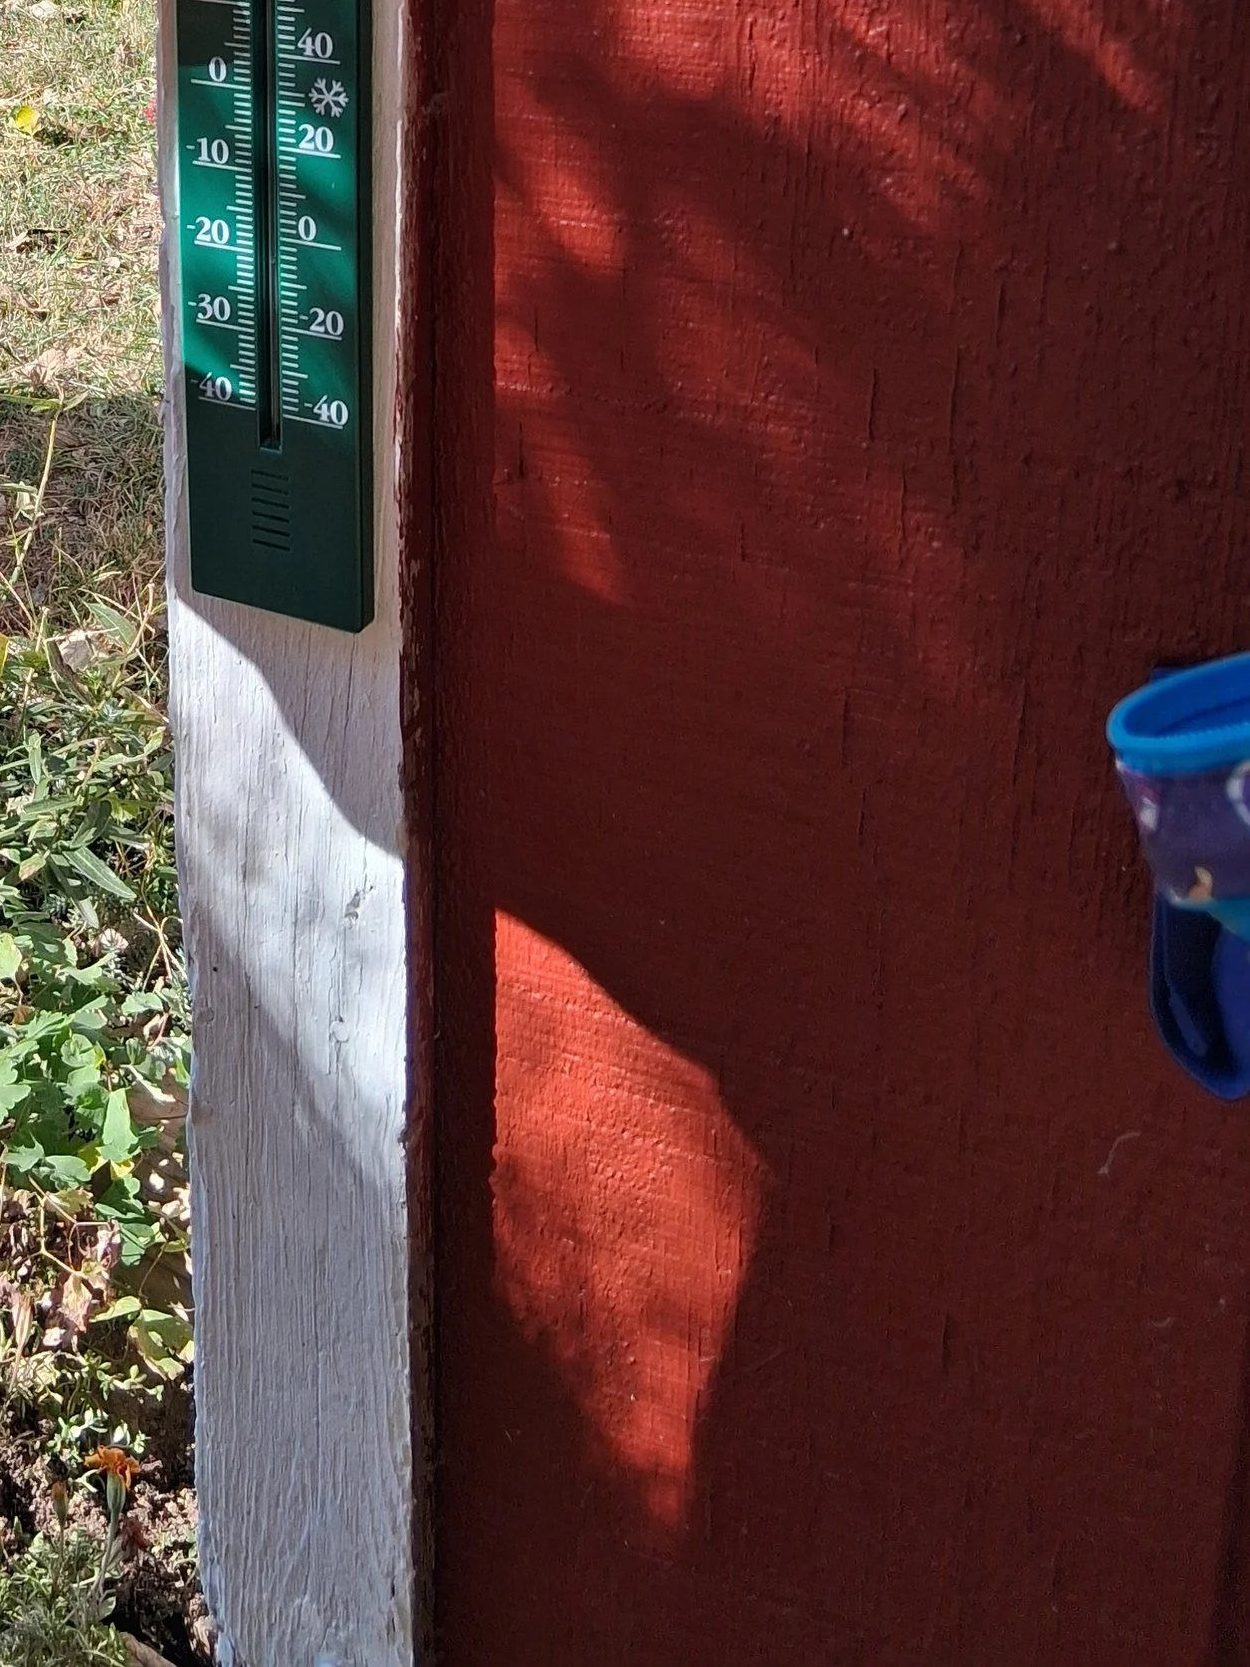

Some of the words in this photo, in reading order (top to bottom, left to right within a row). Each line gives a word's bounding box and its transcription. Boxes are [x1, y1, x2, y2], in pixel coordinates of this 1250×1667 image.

[297, 28, 333, 58] 40
[208, 56, 227, 83] 0
[186, 136, 229, 164] -10
[298, 123, 334, 153] 20
[186, 216, 230, 245] -20
[298, 215, 317, 242] 0
[188, 293, 231, 321] -30
[299, 307, 344, 336] -20
[304, 395, 349, 426] -40
